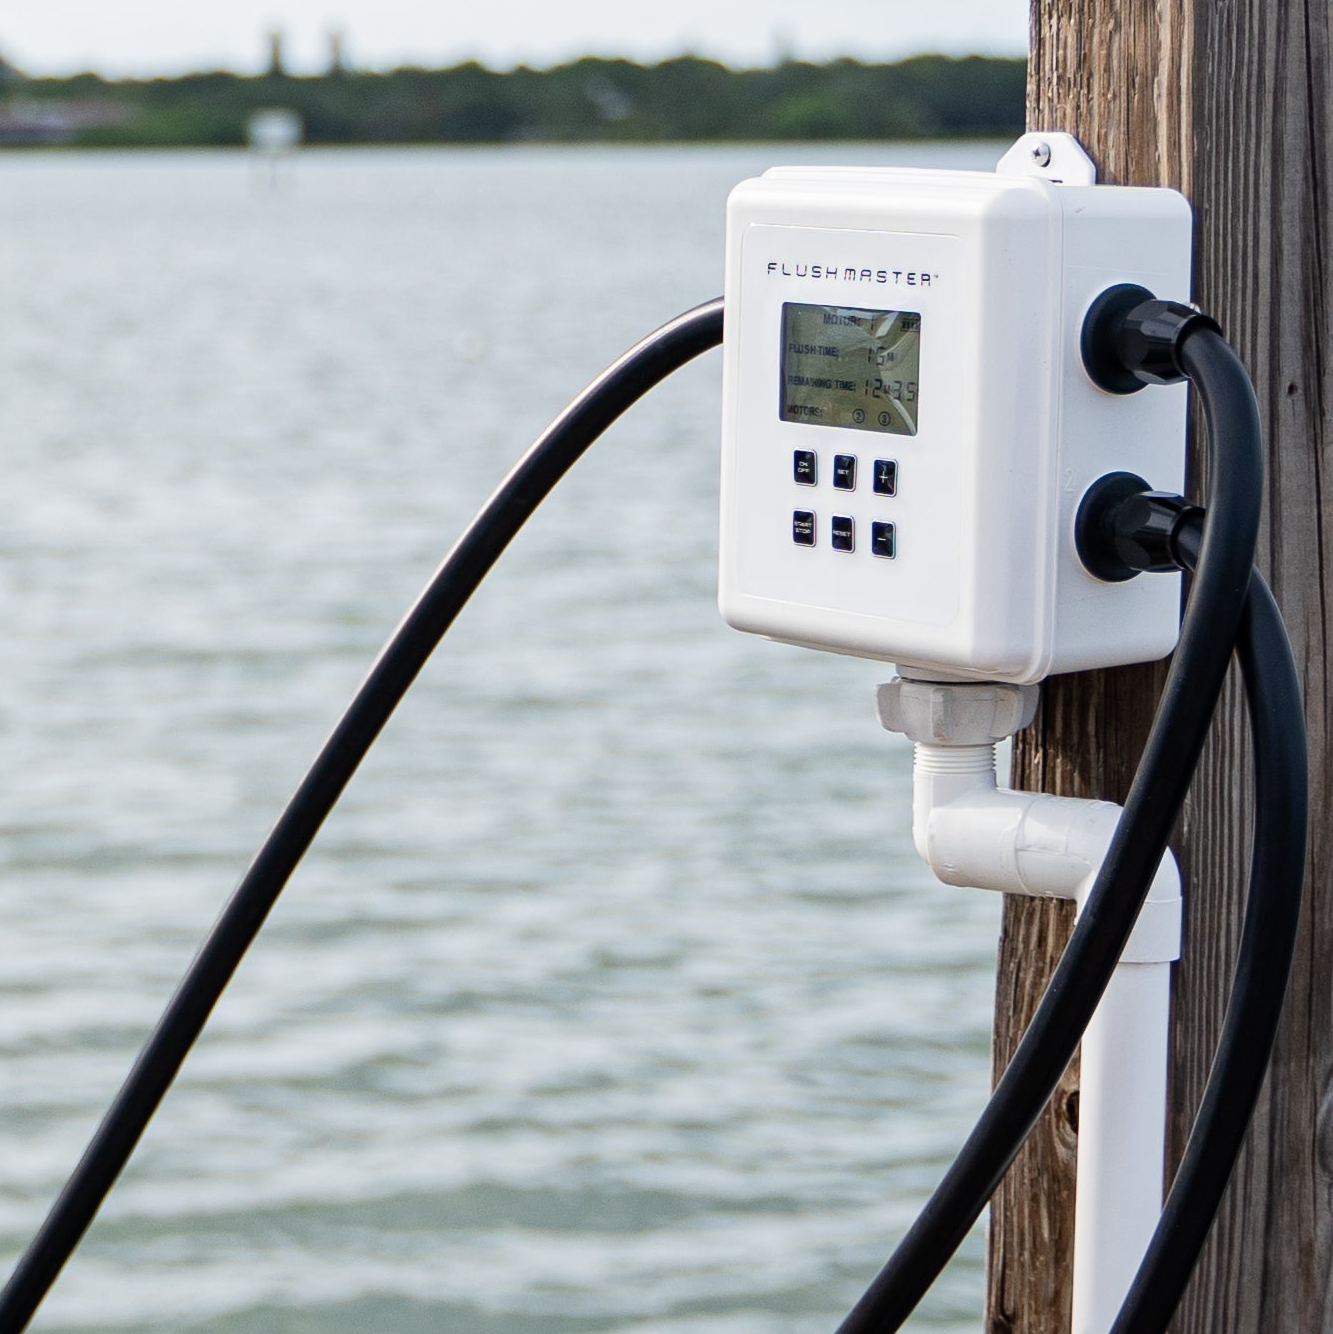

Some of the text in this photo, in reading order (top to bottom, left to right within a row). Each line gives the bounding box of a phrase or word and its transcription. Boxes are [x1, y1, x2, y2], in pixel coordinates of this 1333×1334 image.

[788, 343, 816, 355] FLUSH
[787, 376, 831, 389] REMAINING
[787, 405, 823, 417] MOTORS:
